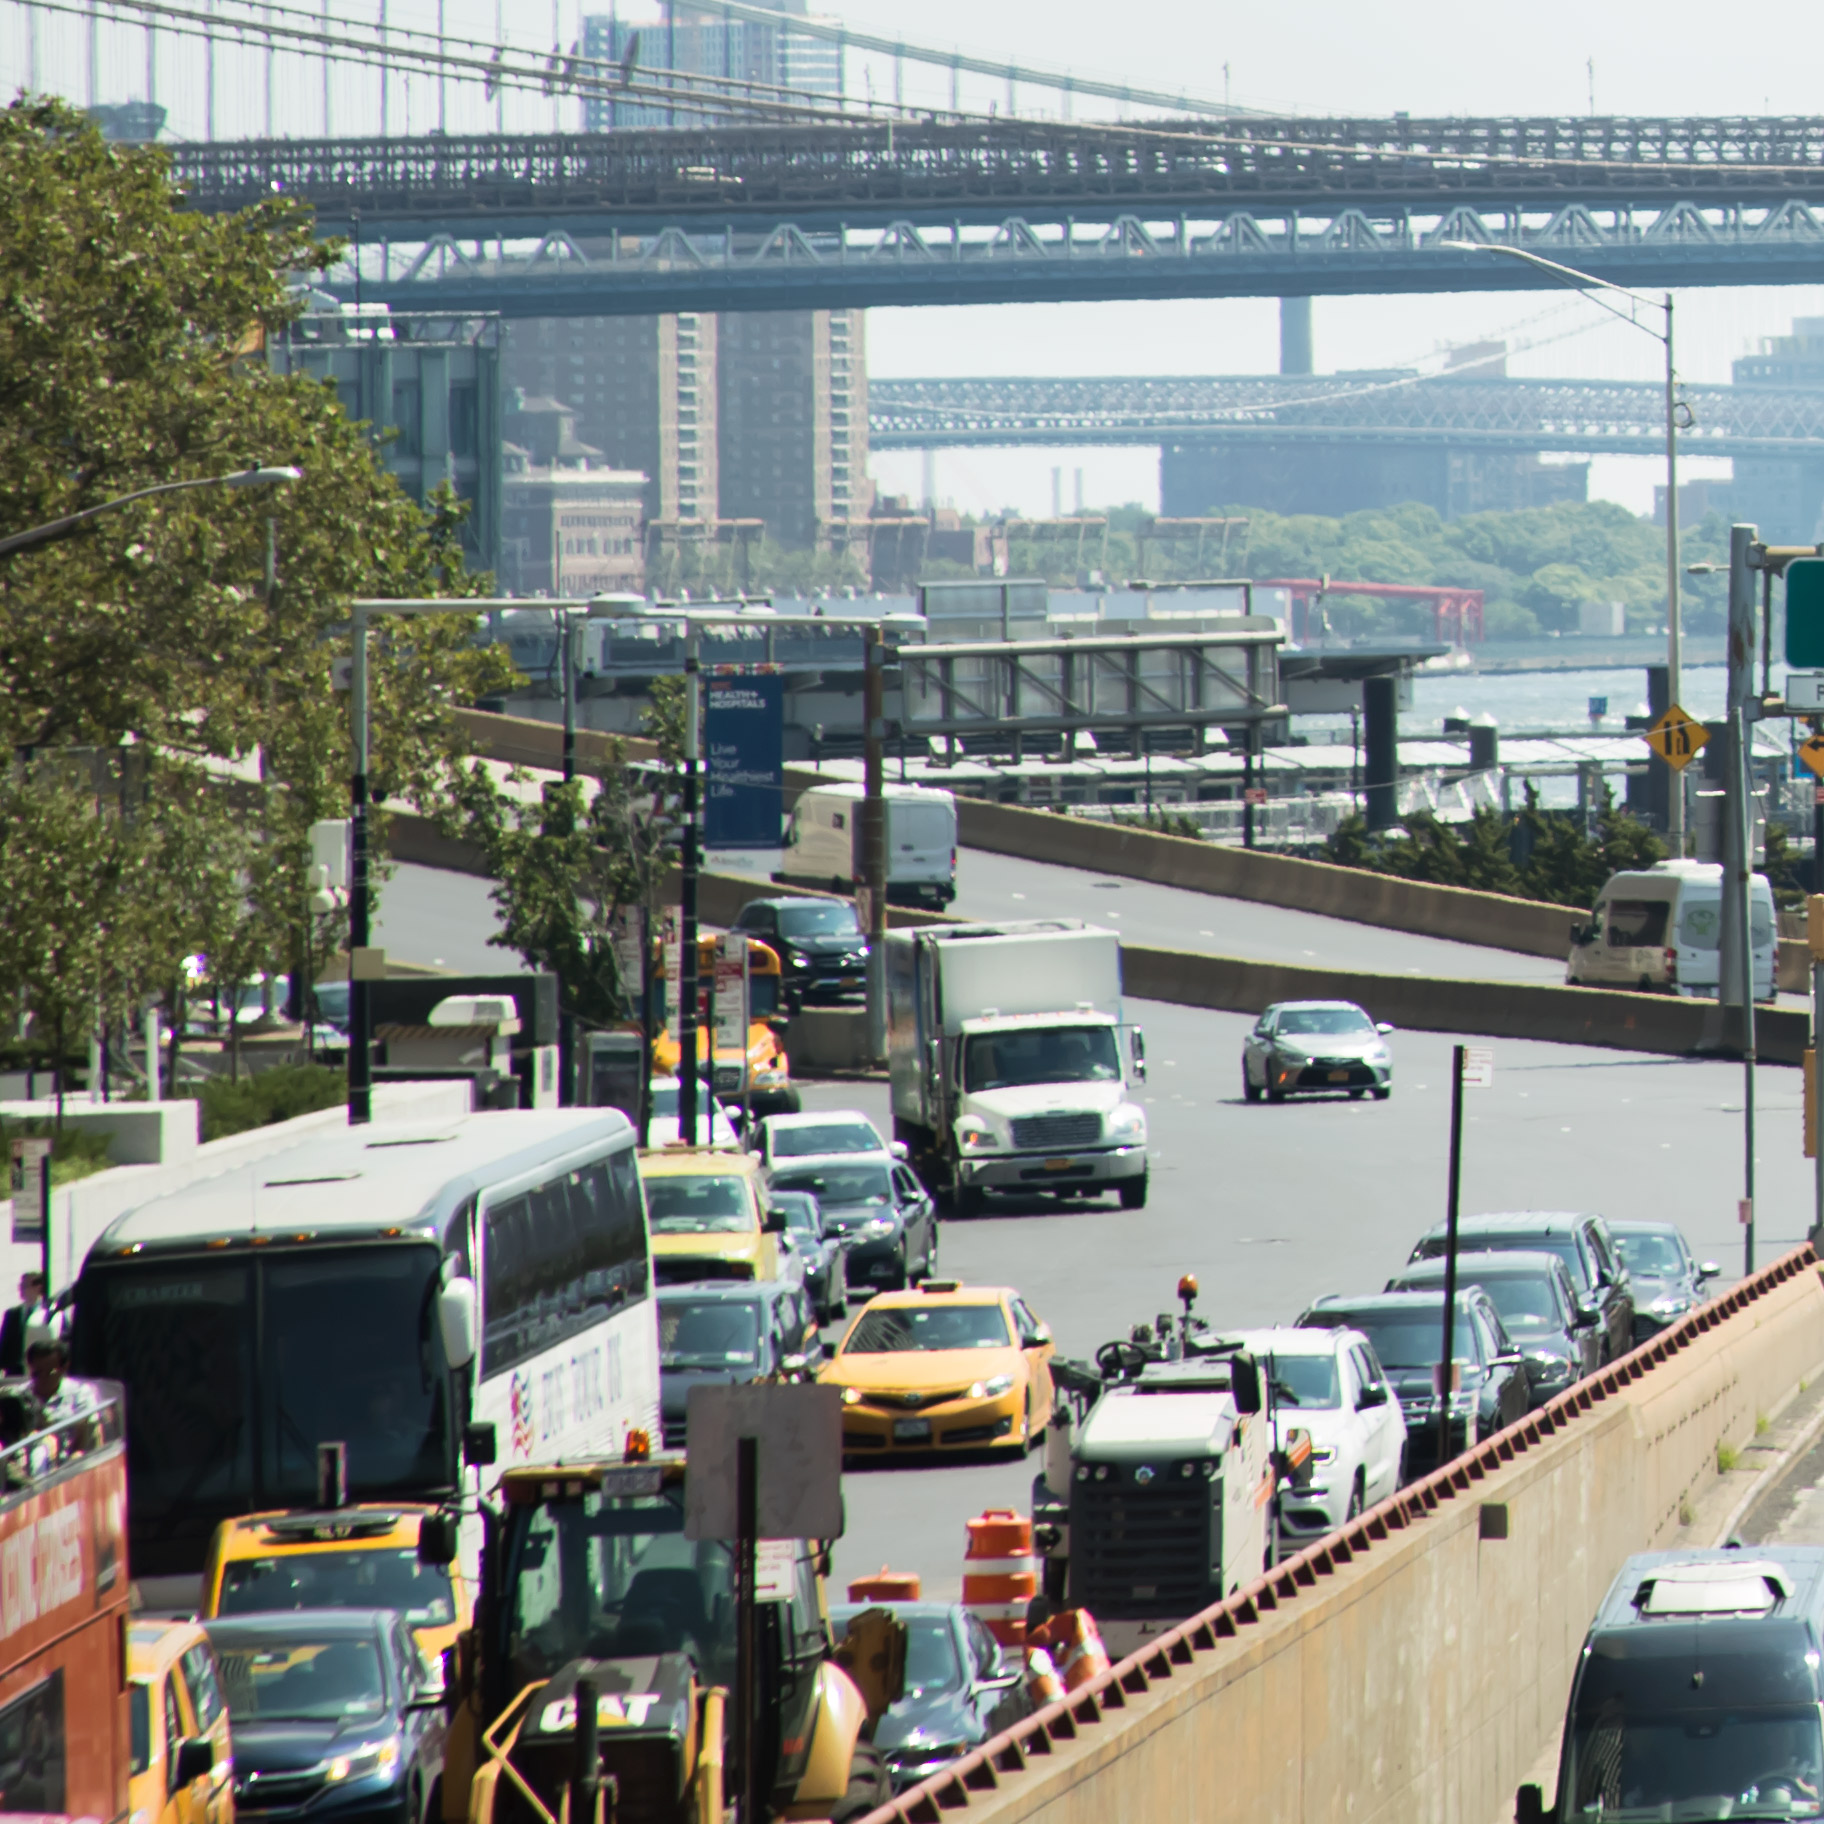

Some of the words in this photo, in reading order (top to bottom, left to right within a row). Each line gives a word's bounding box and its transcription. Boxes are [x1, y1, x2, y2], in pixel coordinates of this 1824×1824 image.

[709, 699, 766, 709] HOSPITALS
[710, 743, 737, 756] Live
[710, 758, 740, 769] Your
[540, 1694, 661, 1732] CAT
